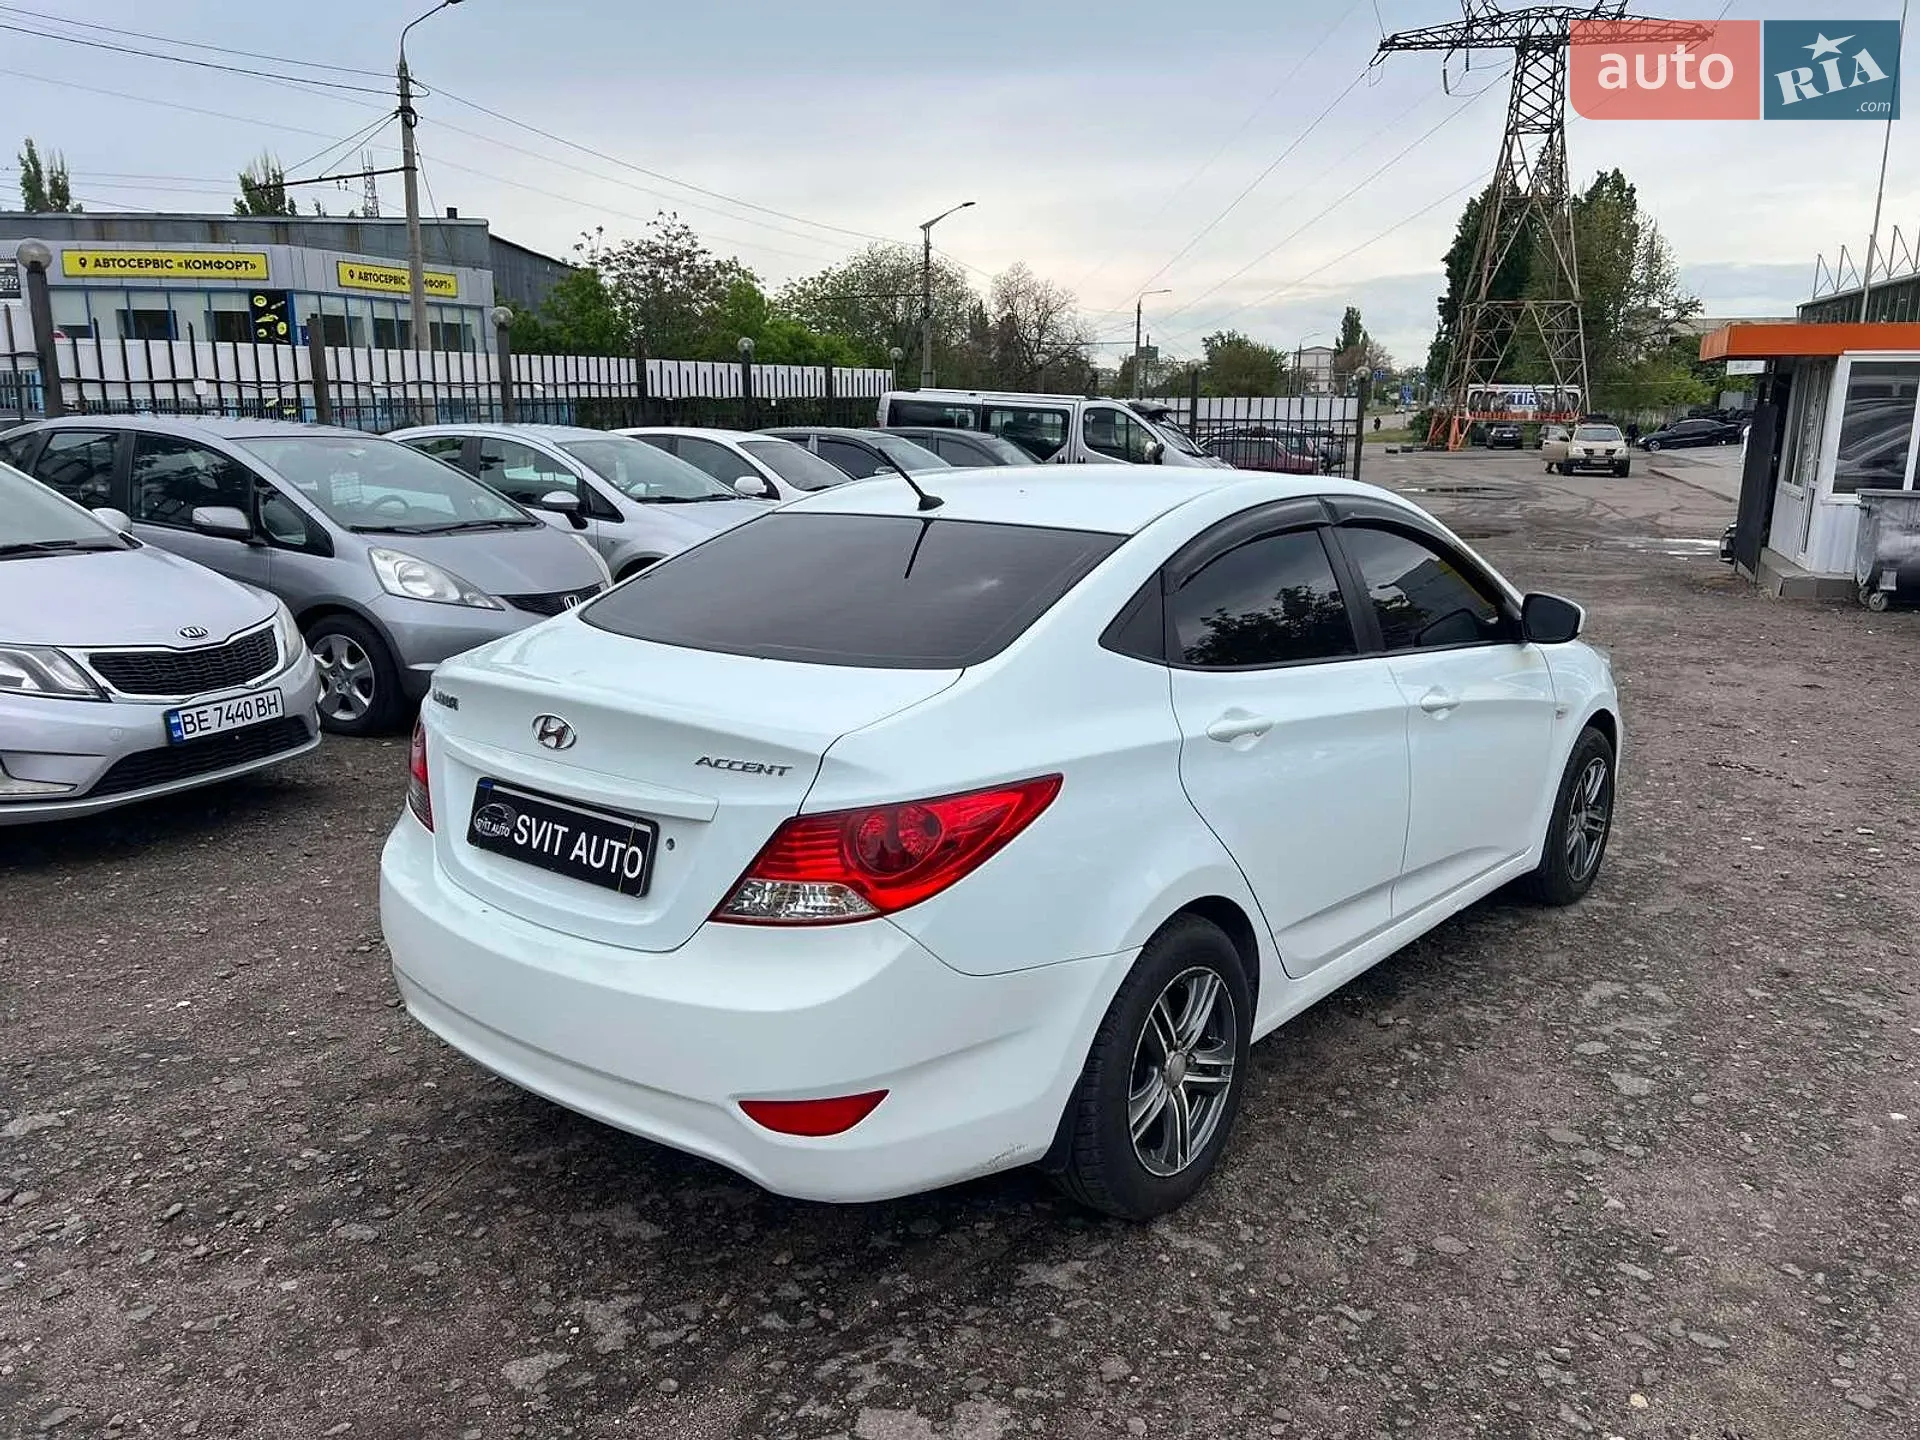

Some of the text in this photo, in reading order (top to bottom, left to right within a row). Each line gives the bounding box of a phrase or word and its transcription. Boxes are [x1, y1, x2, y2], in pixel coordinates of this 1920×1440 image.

[93, 257, 257, 271] АВТОСЕРВІС «КОМФОРТ»
[1512, 392, 1537, 405] TIR
[182, 626, 208, 638] KIA
[181, 694, 279, 735] BE 7440 BH
[695, 756, 793, 776] ACCENT
[513, 814, 643, 879] SVIT AUTO
